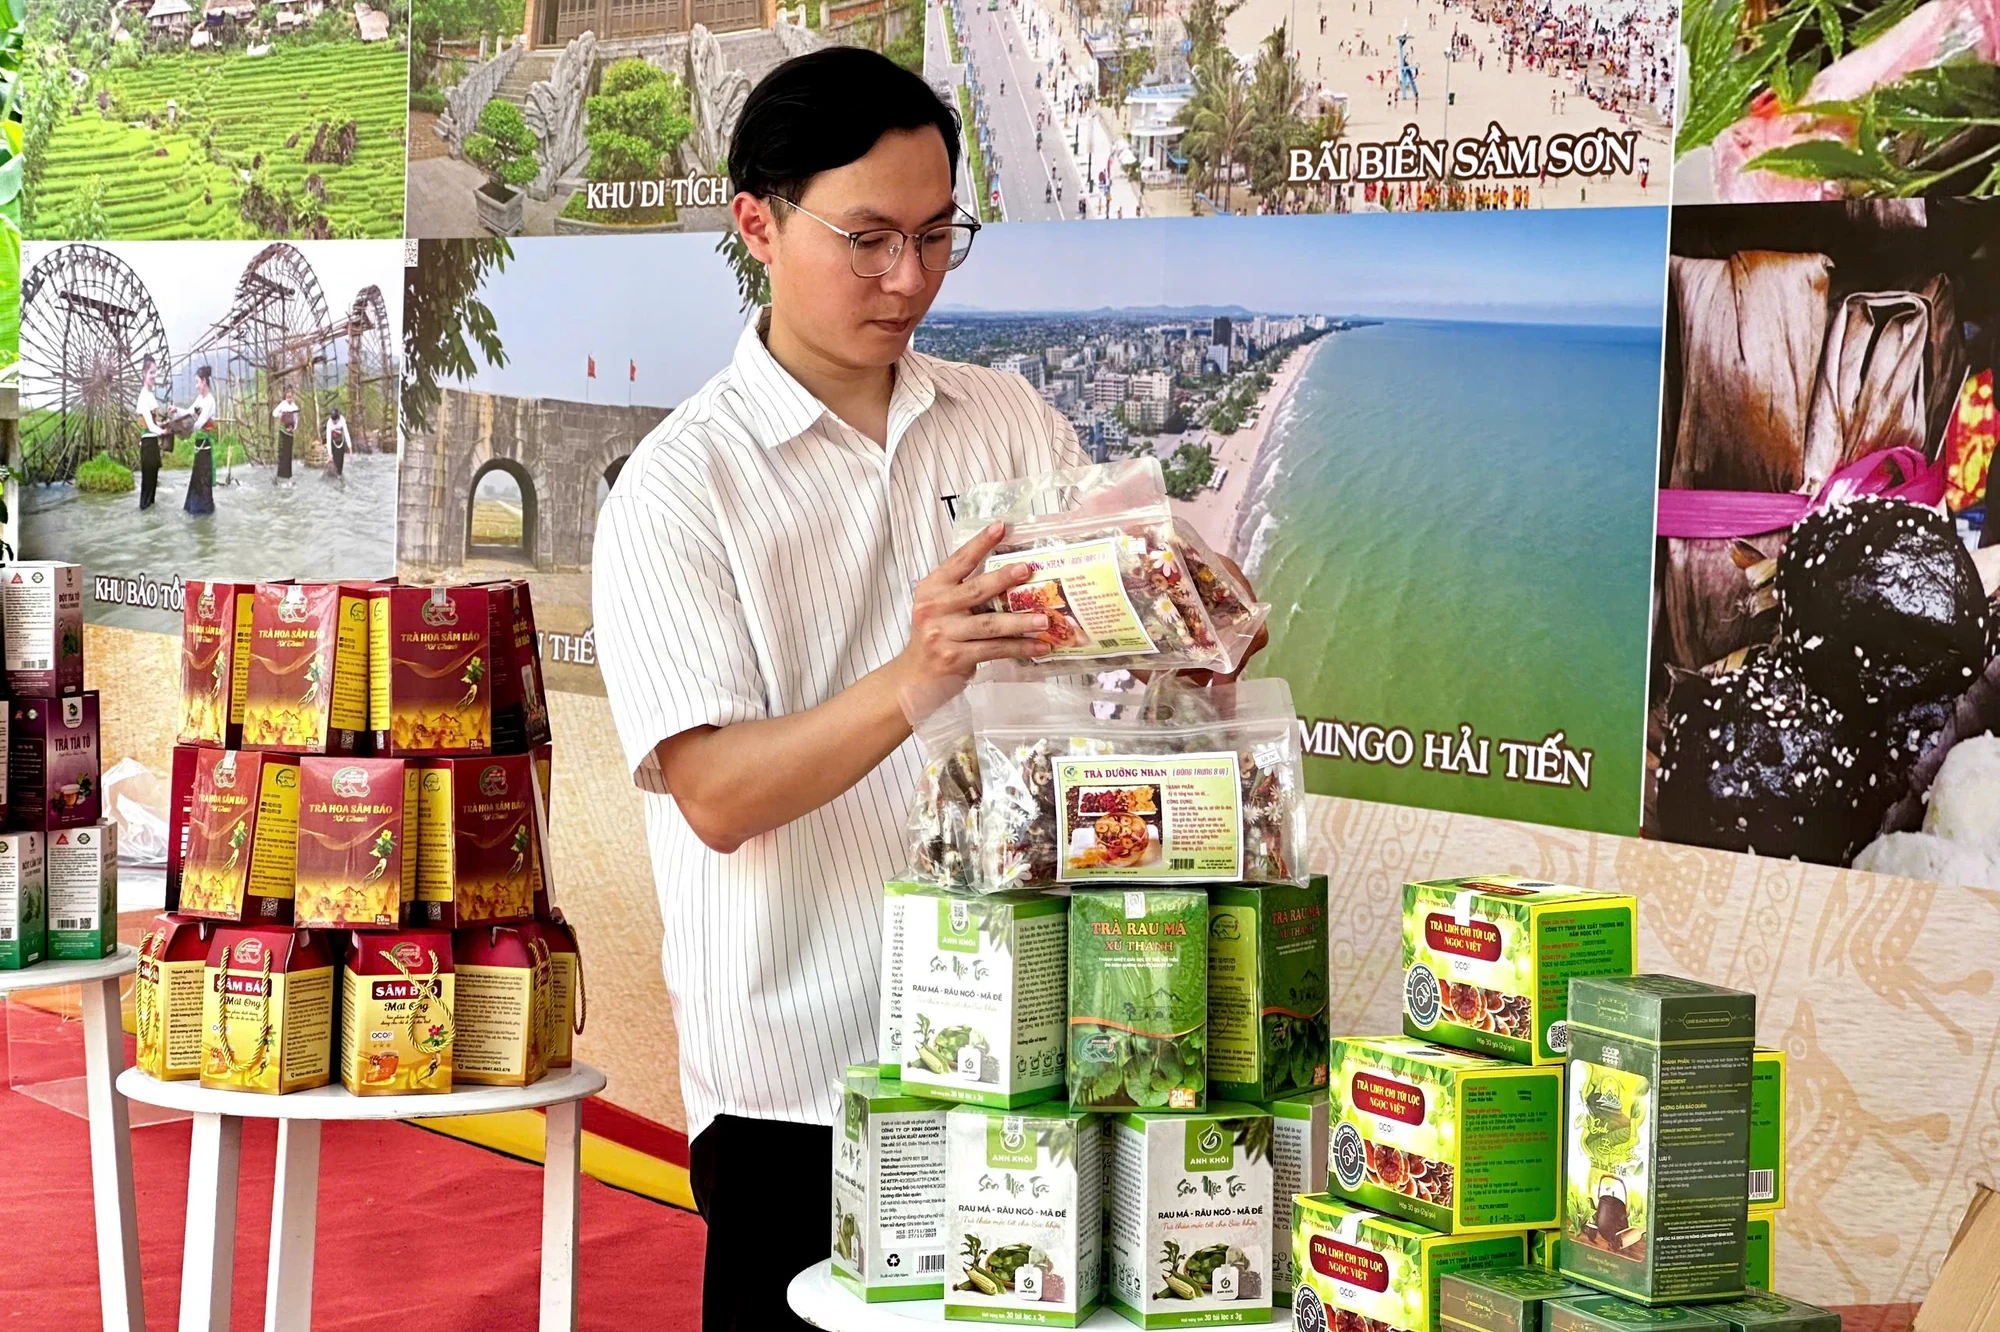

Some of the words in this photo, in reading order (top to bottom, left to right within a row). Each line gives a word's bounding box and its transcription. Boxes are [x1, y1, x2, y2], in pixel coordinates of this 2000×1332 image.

[1289, 141, 1348, 181] BÃI
[1358, 126, 1446, 179] BIỂN
[1546, 132, 1636, 175] SƠN
[587, 182, 635, 209] KHU
[640, 180, 665, 207] DI
[671, 171, 728, 206] TÍCH
[95, 577, 125, 602] KHU
[127, 574, 158, 607] BẢO
[259, 629, 273, 639] TRÀ
[274, 630, 290, 639] HOA
[291, 629, 308, 639] SÂM
[401, 631, 419, 642] TRÀ
[420, 633, 439, 642] HOA
[441, 631, 461, 641] SÂM
[462, 631, 480, 641] BÁO
[55, 735, 68, 751] TRÀ
[70, 734, 80, 750] TÍA
[1424, 725, 1489, 775] HẢI
[1499, 732, 1592, 788] TIẾN
[1084, 767, 1103, 778] TRÀ
[1105, 767, 1138, 778] DƯỠNG
[1140, 768, 1167, 777] NHAN
[309, 803, 327, 813] TRÀ
[328, 804, 349, 813] HOA
[350, 802, 372, 814] SÂM
[373, 802, 393, 814] BÁO
[463, 801, 477, 814] TRÀ
[478, 804, 494, 812] HOA
[494, 802, 511, 811] SÂM
[1272, 908, 1289, 925] TRÀ
[1290, 907, 1307, 921] RAU
[1091, 919, 1123, 936] TRÀ
[1127, 922, 1159, 936] RAU
[1164, 919, 1187, 935] MÁ
[1290, 923, 1315, 937] THANH
[1430, 919, 1443, 932] TRÀ
[1444, 923, 1459, 935] LINH
[1460, 926, 1471, 937] CHI
[1473, 926, 1483, 939] TÚI
[1484, 930, 1497, 943] LỌC
[1104, 941, 1123, 951] XỨ
[1127, 941, 1174, 951] THANH
[1444, 937, 1464, 951] NGỌC
[1465, 939, 1482, 953] VIỆT
[376, 984, 406, 997] SÂM
[410, 983, 438, 996] BO
[912, 984, 926, 992] RAU
[928, 985, 939, 994] MÁ
[944, 987, 958, 996] RÂU
[960, 988, 975, 997] NGÔ
[980, 991, 992, 1000] MÃ
[1486, 1038, 1492, 1046] 30
[1171, 1090, 1183, 1100] 20
[1356, 1079, 1369, 1092] TRÀ
[1370, 1083, 1384, 1096] LINH
[1385, 1088, 1396, 1099] CHI
[1397, 1090, 1407, 1102] TÚI
[1408, 1094, 1420, 1107] LỌC
[1369, 1097, 1389, 1111] NGỌC
[1389, 1101, 1406, 1115] VIỆT
[992, 1154, 1010, 1163] ANH
[1012, 1154, 1032, 1163] KHÔI
[1190, 1157, 1208, 1166] ANH
[1209, 1156, 1229, 1164] KHÔI
[958, 1204, 976, 1213] RAU
[977, 1204, 991, 1213] MÁ
[997, 1206, 1015, 1214] RÂU
[1016, 1206, 1034, 1216] NGÔ
[1040, 1208, 1054, 1217] MÃ
[1054, 1208, 1067, 1218] ĐỀ
[1158, 1212, 1175, 1220] RAU
[1176, 1209, 1189, 1218] MÁ
[1195, 1208, 1212, 1217] RÂU
[1213, 1207, 1231, 1216] NGÔ
[1237, 1207, 1251, 1215] MÃ
[1251, 1205, 1263, 1215] ĐỀ
[1314, 1242, 1327, 1256] TRÀ
[1328, 1247, 1344, 1260] LINH
[1345, 1252, 1357, 1264] CHI
[1357, 1256, 1369, 1268] TÚI
[1369, 1259, 1383, 1273] LỌC
[1328, 1261, 1349, 1275] NGỌC
[1351, 1266, 1368, 1280] VIỆT
[1006, 1311, 1013, 1319] 30
[1221, 1313, 1229, 1321] lọc
[1235, 1313, 1242, 1321] 3g
